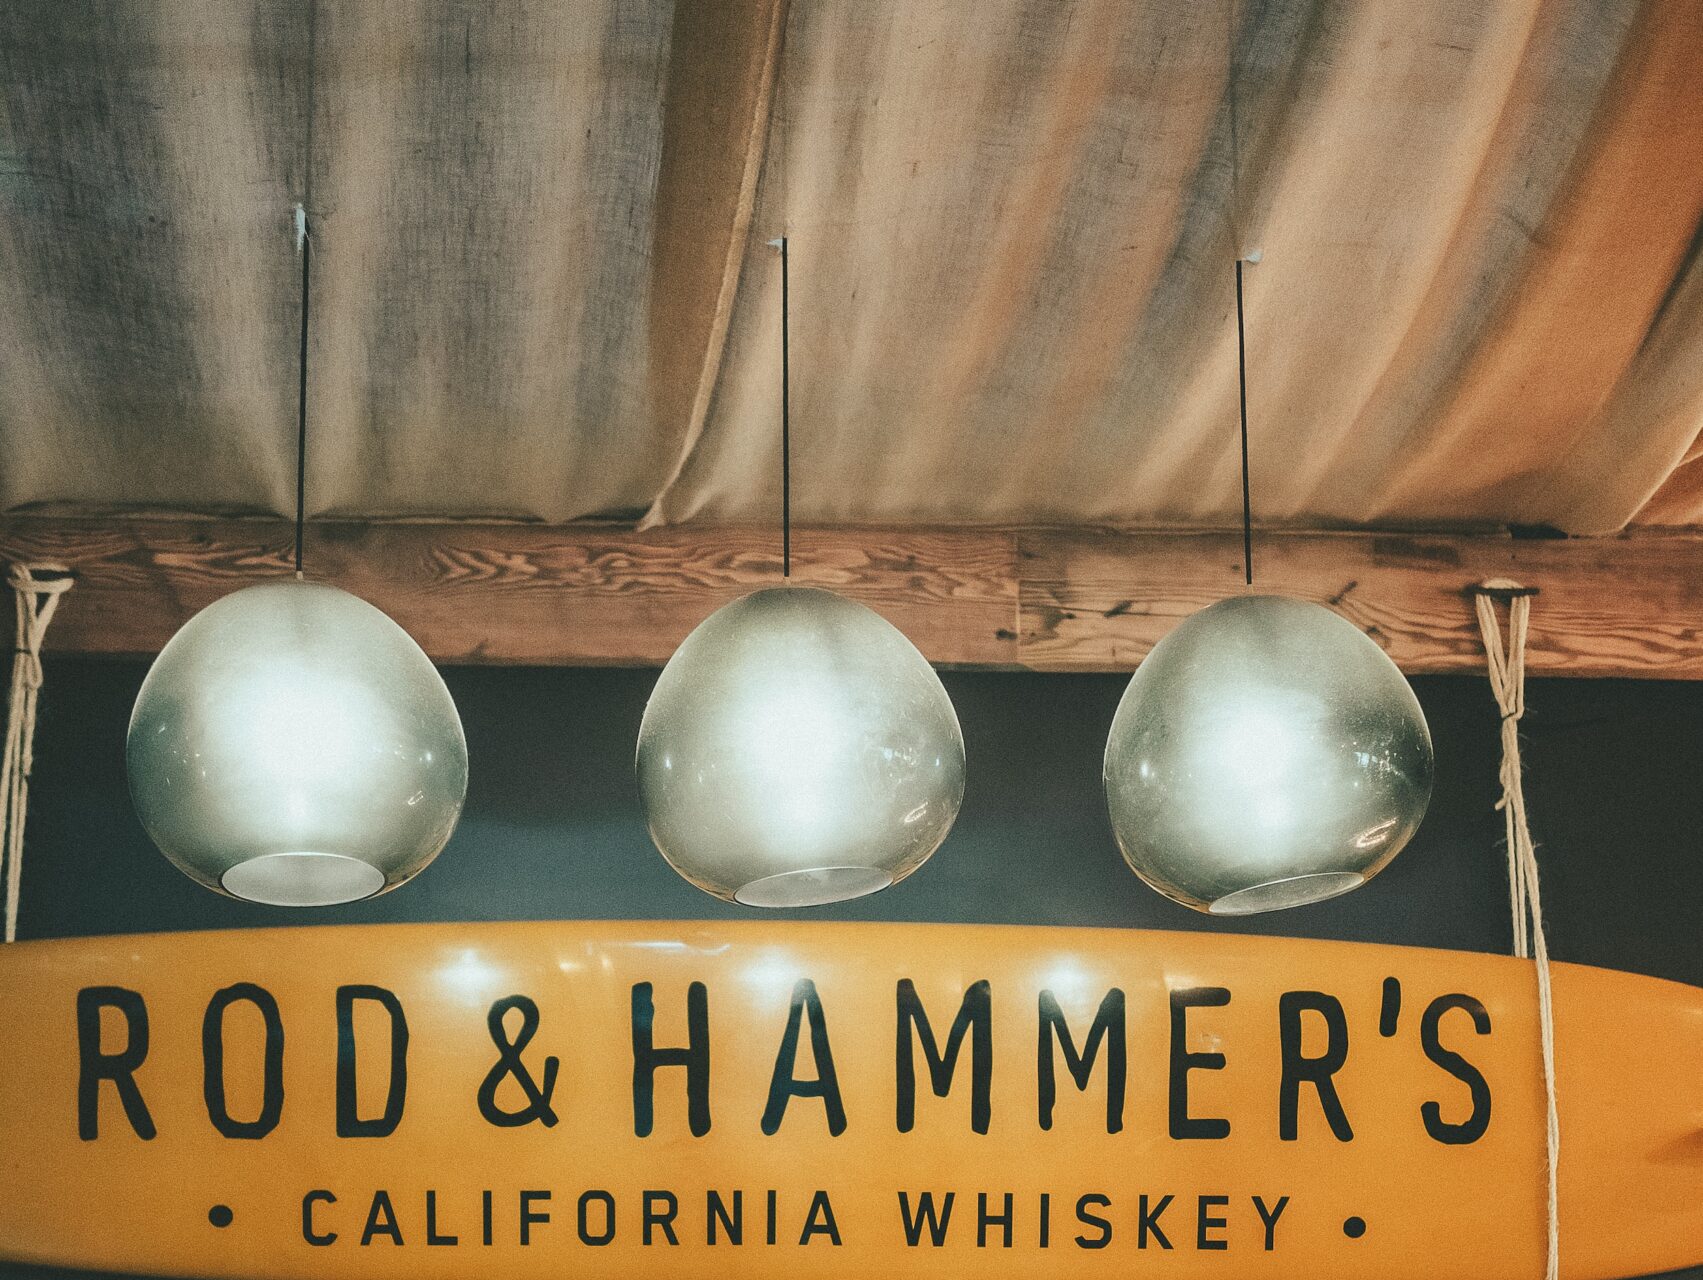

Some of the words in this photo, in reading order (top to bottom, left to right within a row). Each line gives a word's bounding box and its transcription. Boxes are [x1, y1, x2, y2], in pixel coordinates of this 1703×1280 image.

[75, 981, 410, 1143] ROD
[476, 994, 560, 1129] &
[631, 976, 1492, 1146] HAMMER'S
[301, 1189, 843, 1247] CALIFORNIA
[897, 1191, 1290, 1251] WHISKEY
